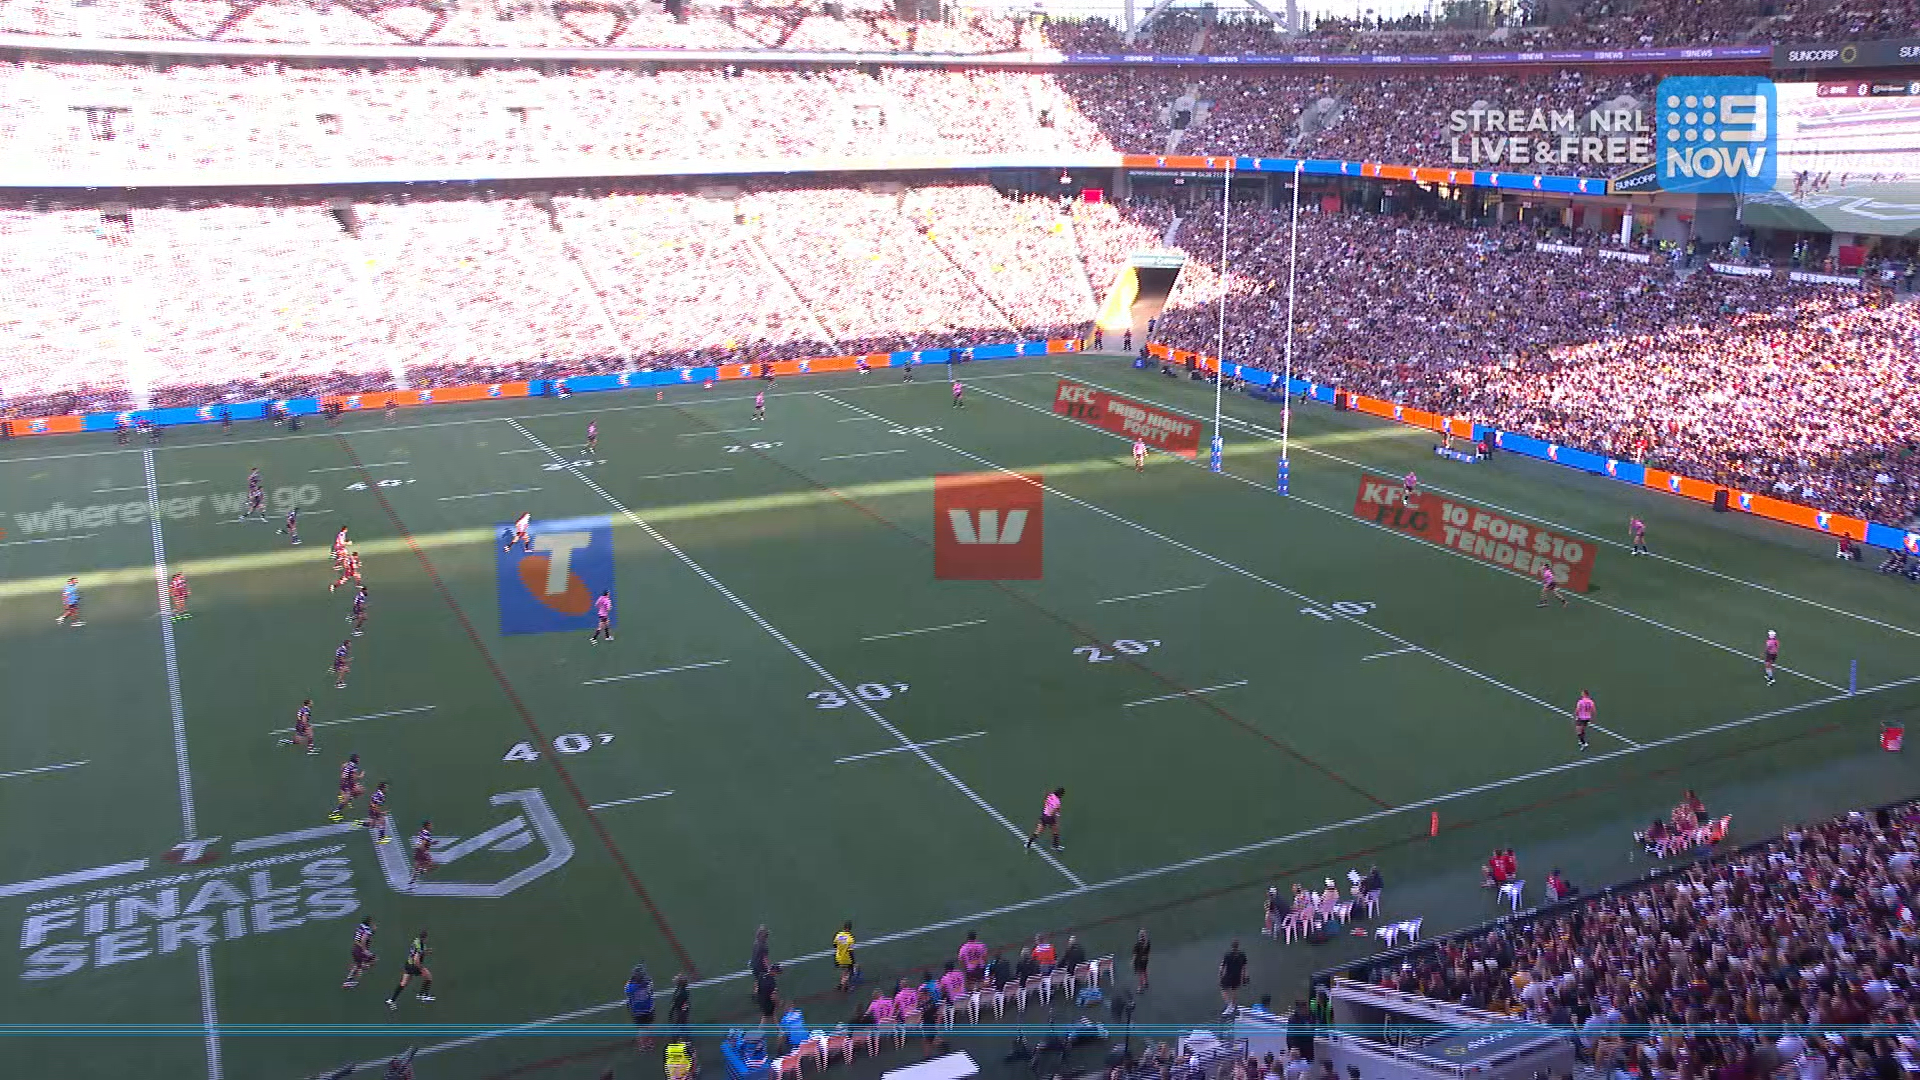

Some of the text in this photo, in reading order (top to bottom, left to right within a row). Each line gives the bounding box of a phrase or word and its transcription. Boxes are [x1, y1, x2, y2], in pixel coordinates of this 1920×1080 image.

[1788, 49, 1839, 61] SUNCORP
[1614, 173, 1657, 191] SUNCORP
[1058, 385, 1098, 405] KFC
[1123, 418, 1169, 443] FOOTY
[1148, 412, 1193, 437] NIGHT
[273, 484, 321, 512] go
[1441, 503, 1583, 563] 10 FOR $10
[1442, 525, 1570, 584] TENDERS
[26, 843, 346, 912] NRL TELSTRA PREMIERSHIP
[20, 857, 354, 950] FINALS
[19, 887, 361, 981] SERIES
